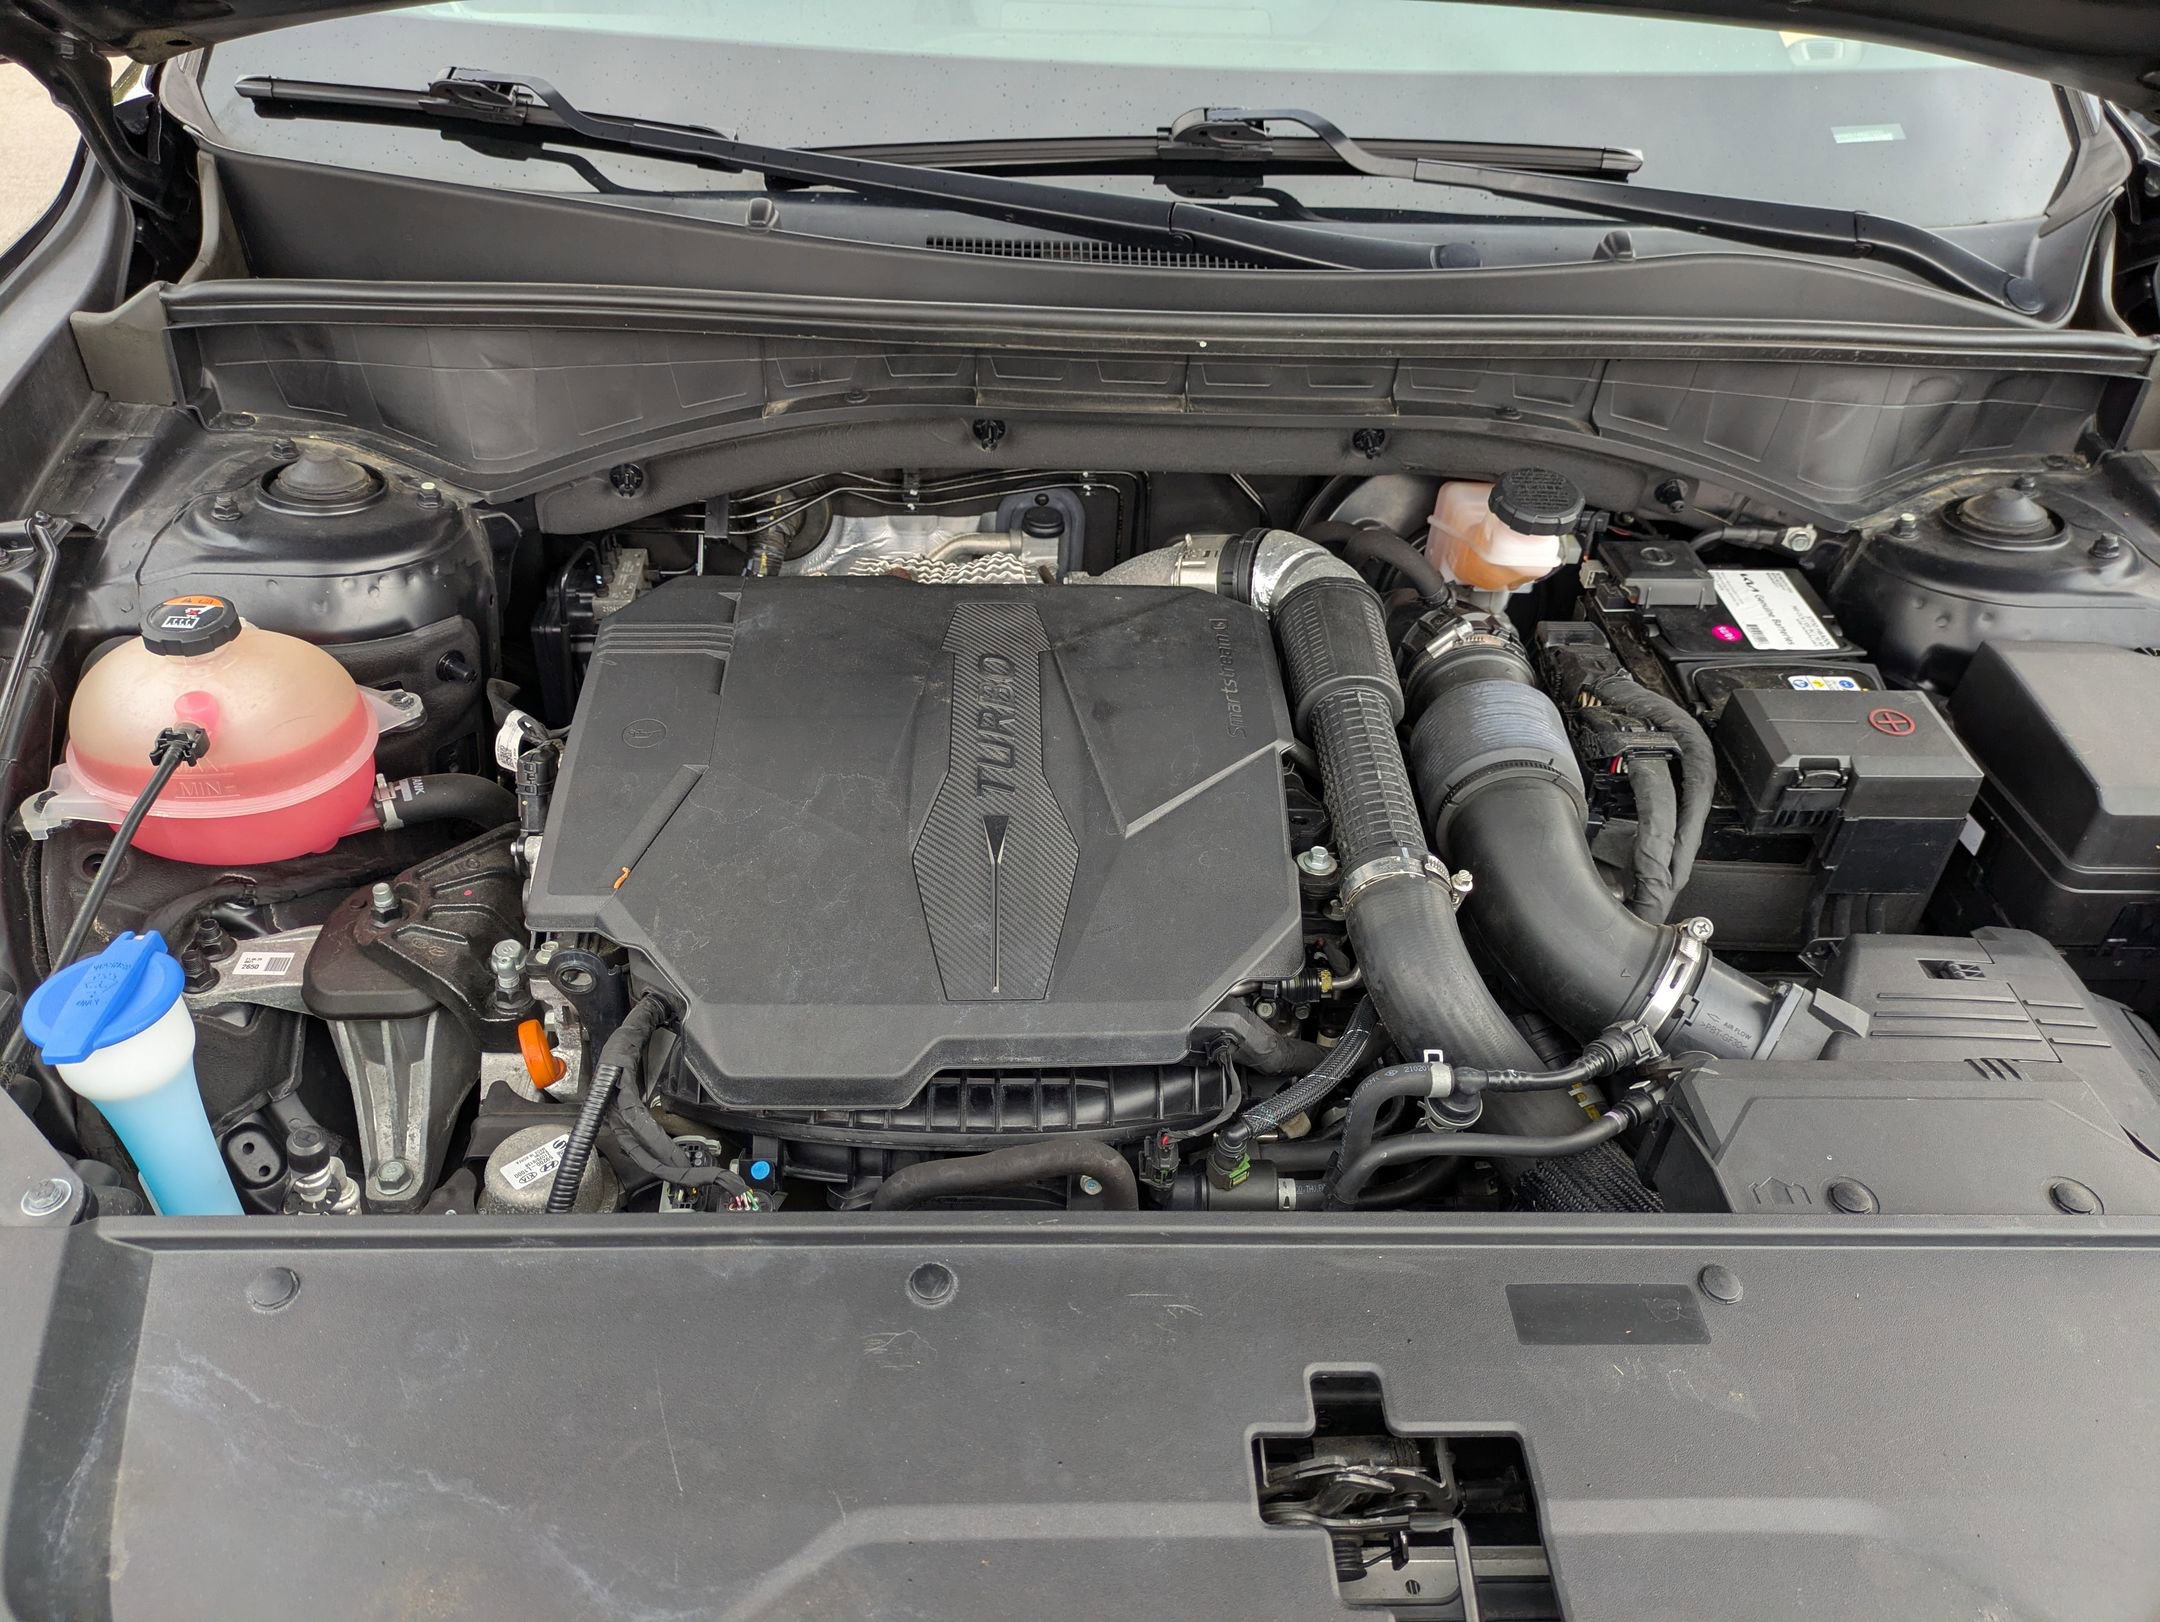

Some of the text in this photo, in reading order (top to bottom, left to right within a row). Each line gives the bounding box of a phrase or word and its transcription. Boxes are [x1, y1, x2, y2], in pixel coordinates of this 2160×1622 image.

[1216, 633, 1248, 740] Smartstream
[976, 653, 1016, 800] TURBO
[179, 781, 222, 797] MIN
[411, 776, 425, 796] ANK
[1723, 1022, 1752, 1040] AIR FLOW
